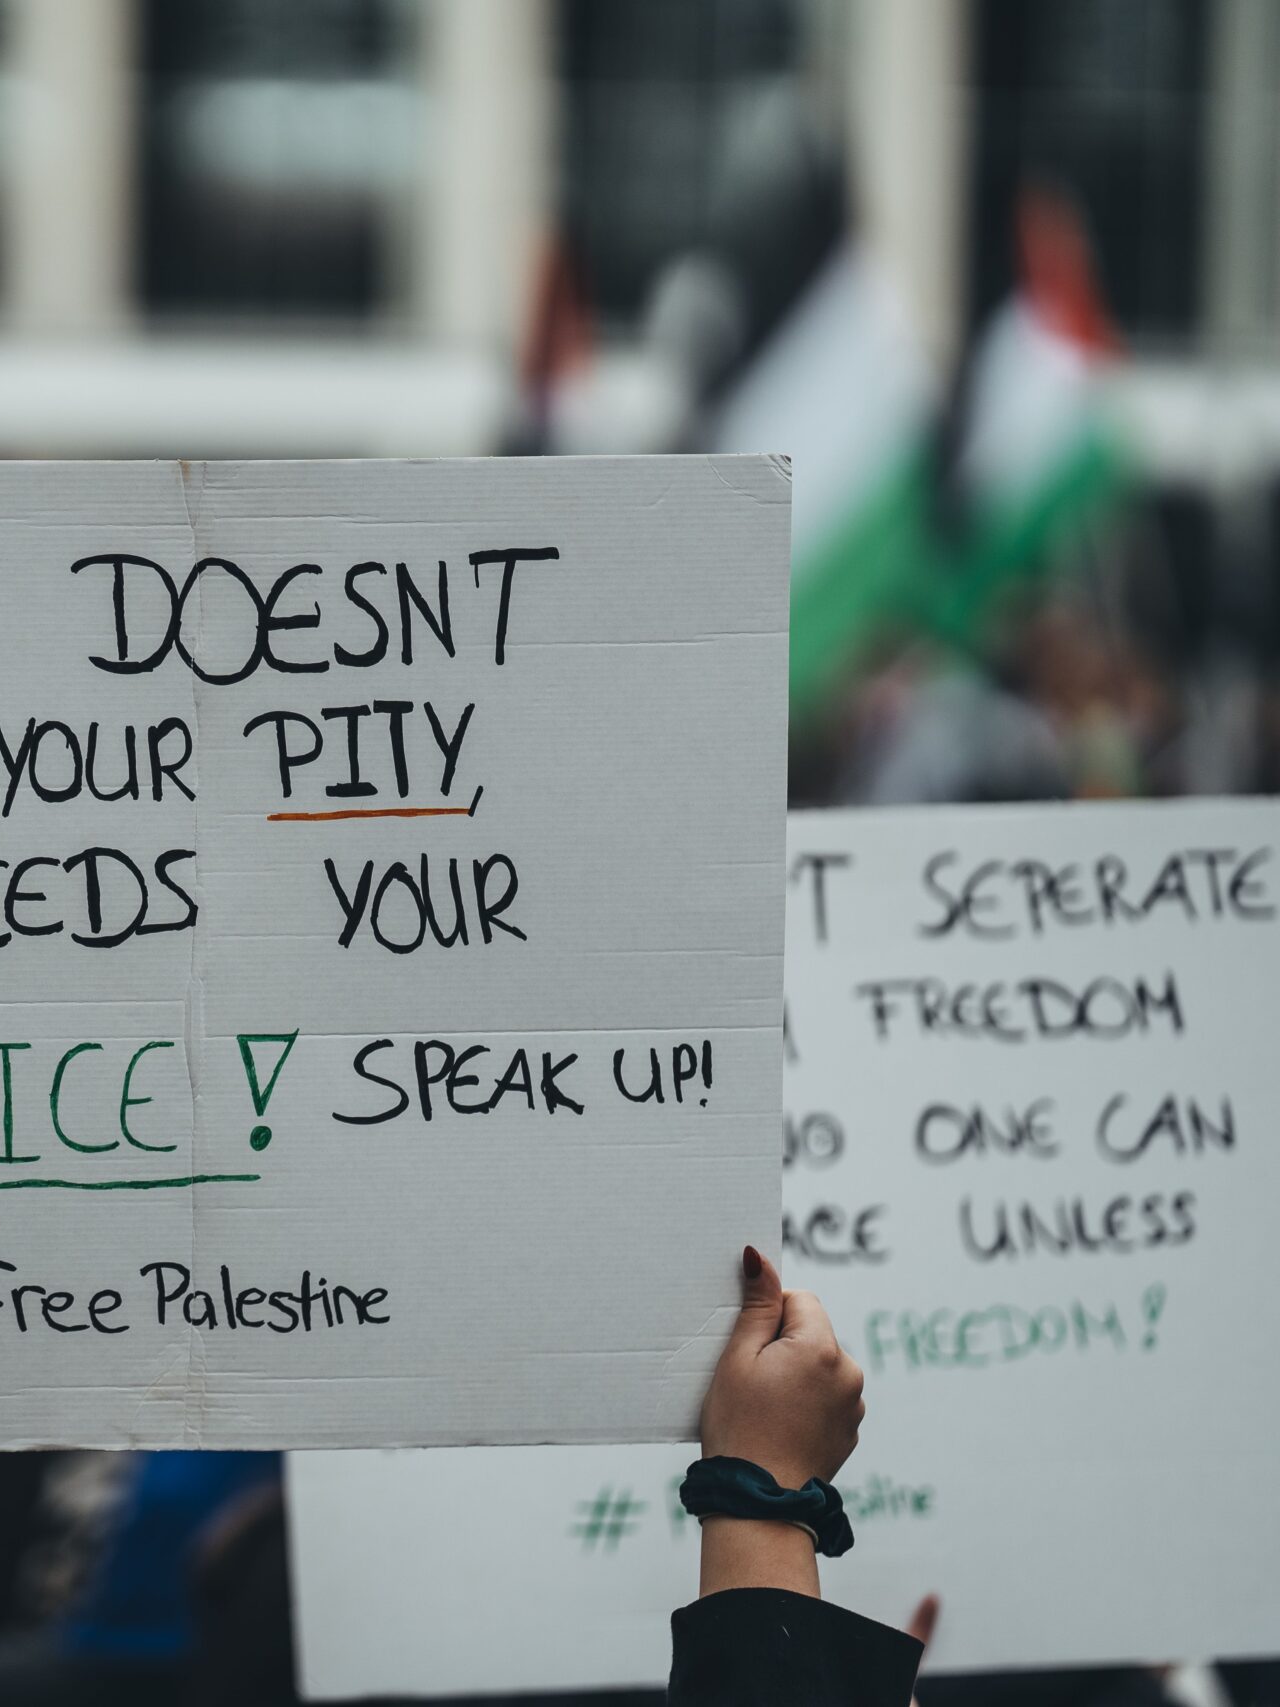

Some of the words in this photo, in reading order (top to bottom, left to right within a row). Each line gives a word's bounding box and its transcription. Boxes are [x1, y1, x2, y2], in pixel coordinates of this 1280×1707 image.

[243, 699, 484, 817] PITY,
[323, 853, 527, 955] YOUR
[918, 847, 1278, 941] SEPERATE
[855, 970, 1186, 1044] FREEDOM
[332, 1039, 585, 1125] SPEAK
[613, 1039, 713, 1108] UP!
[913, 1099, 1059, 1165] ONE
[1096, 1093, 1237, 1165] CAN
[959, 1191, 1197, 1263] UNLESS
